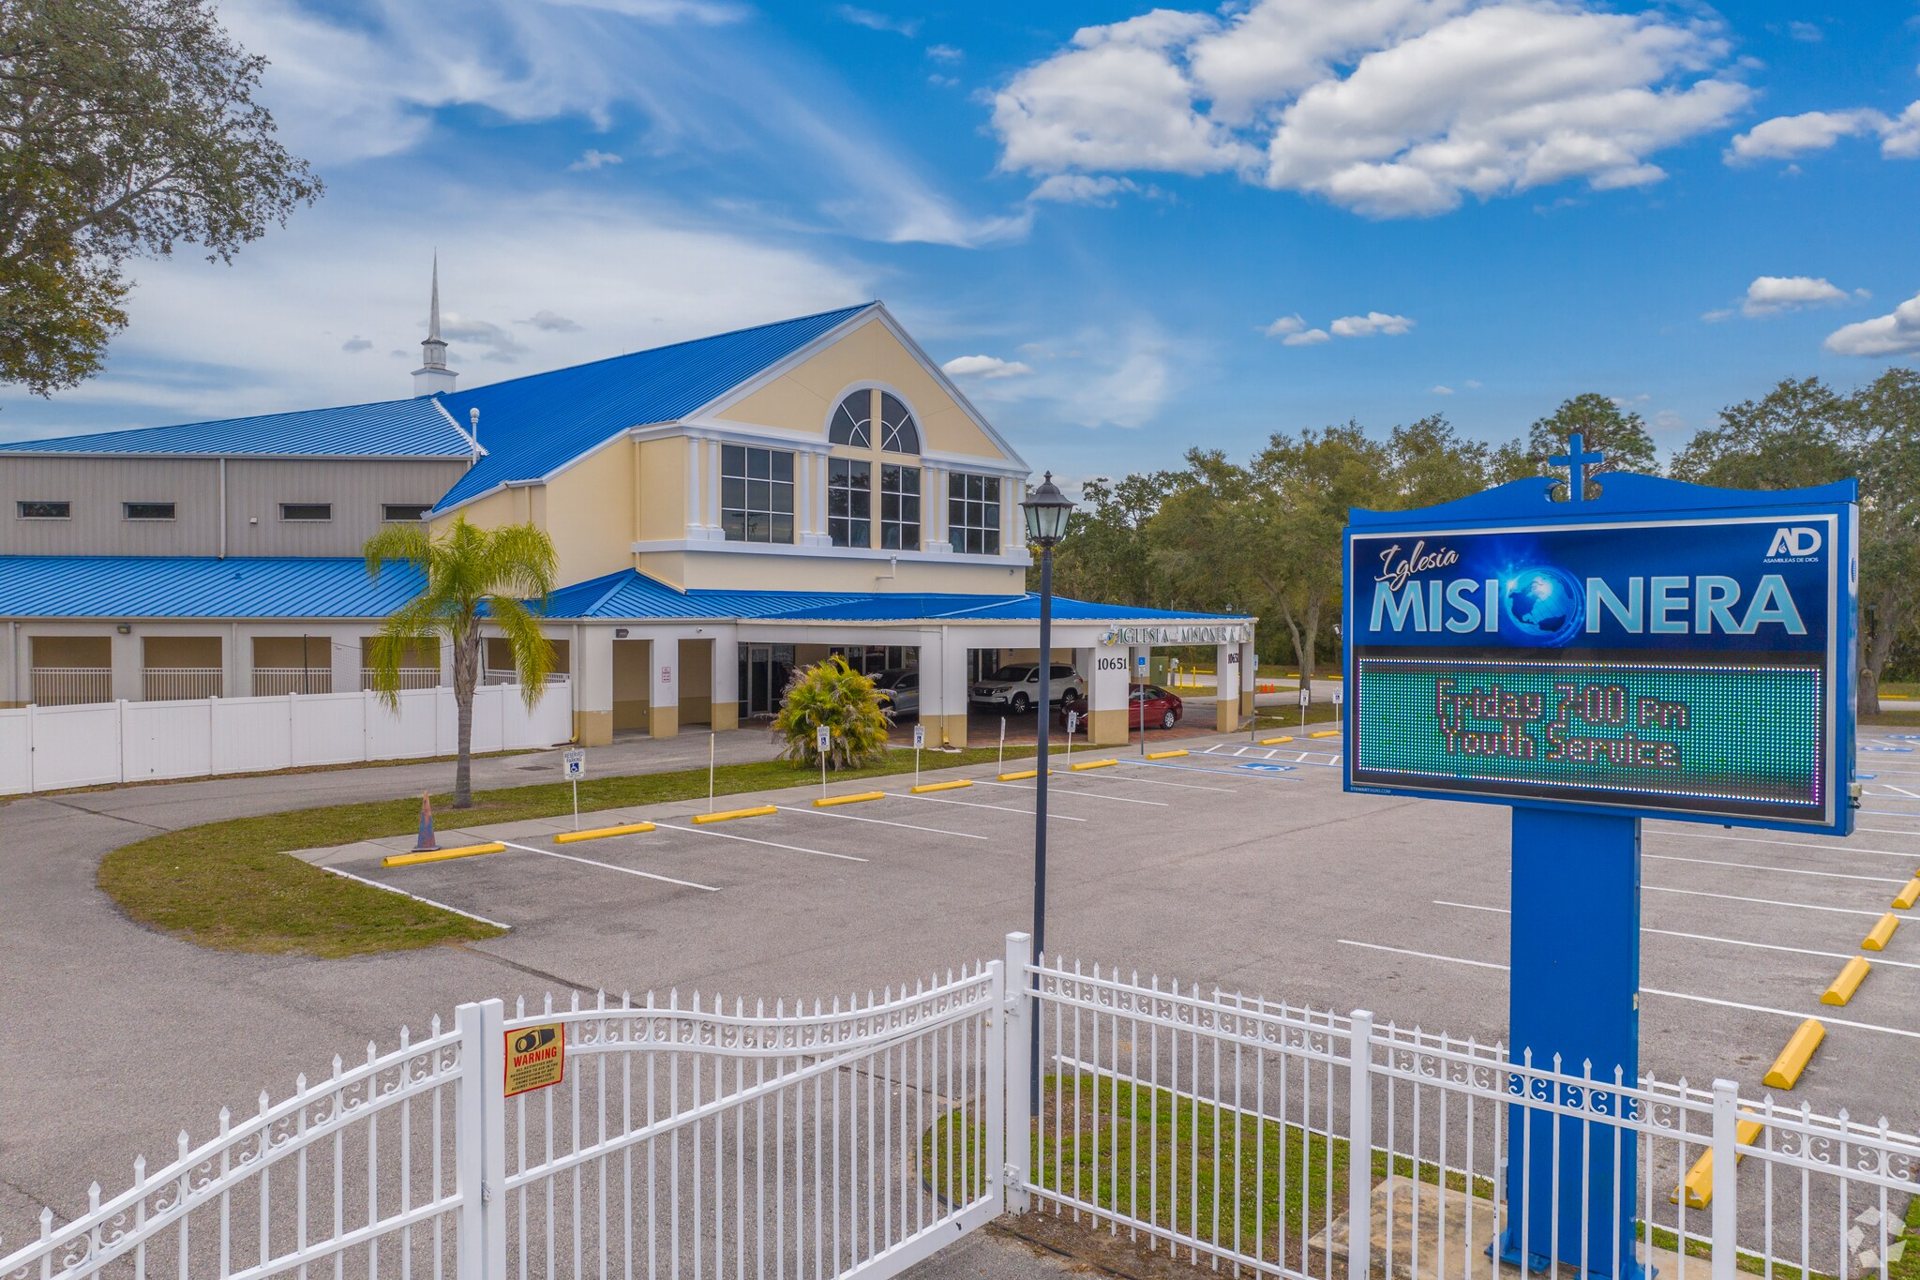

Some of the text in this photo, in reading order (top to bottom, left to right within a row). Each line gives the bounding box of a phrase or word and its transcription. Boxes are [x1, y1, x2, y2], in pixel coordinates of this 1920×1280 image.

[1766, 527, 1822, 557] AD
[1374, 540, 1459, 592] Iglesia
[1097, 657, 1127, 670] 10651
[1437, 679, 1543, 719] Friday
[1556, 683, 1626, 723] 7:00
[1441, 716, 1679, 767] Youth Service
[514, 1046, 557, 1067] WARNING
